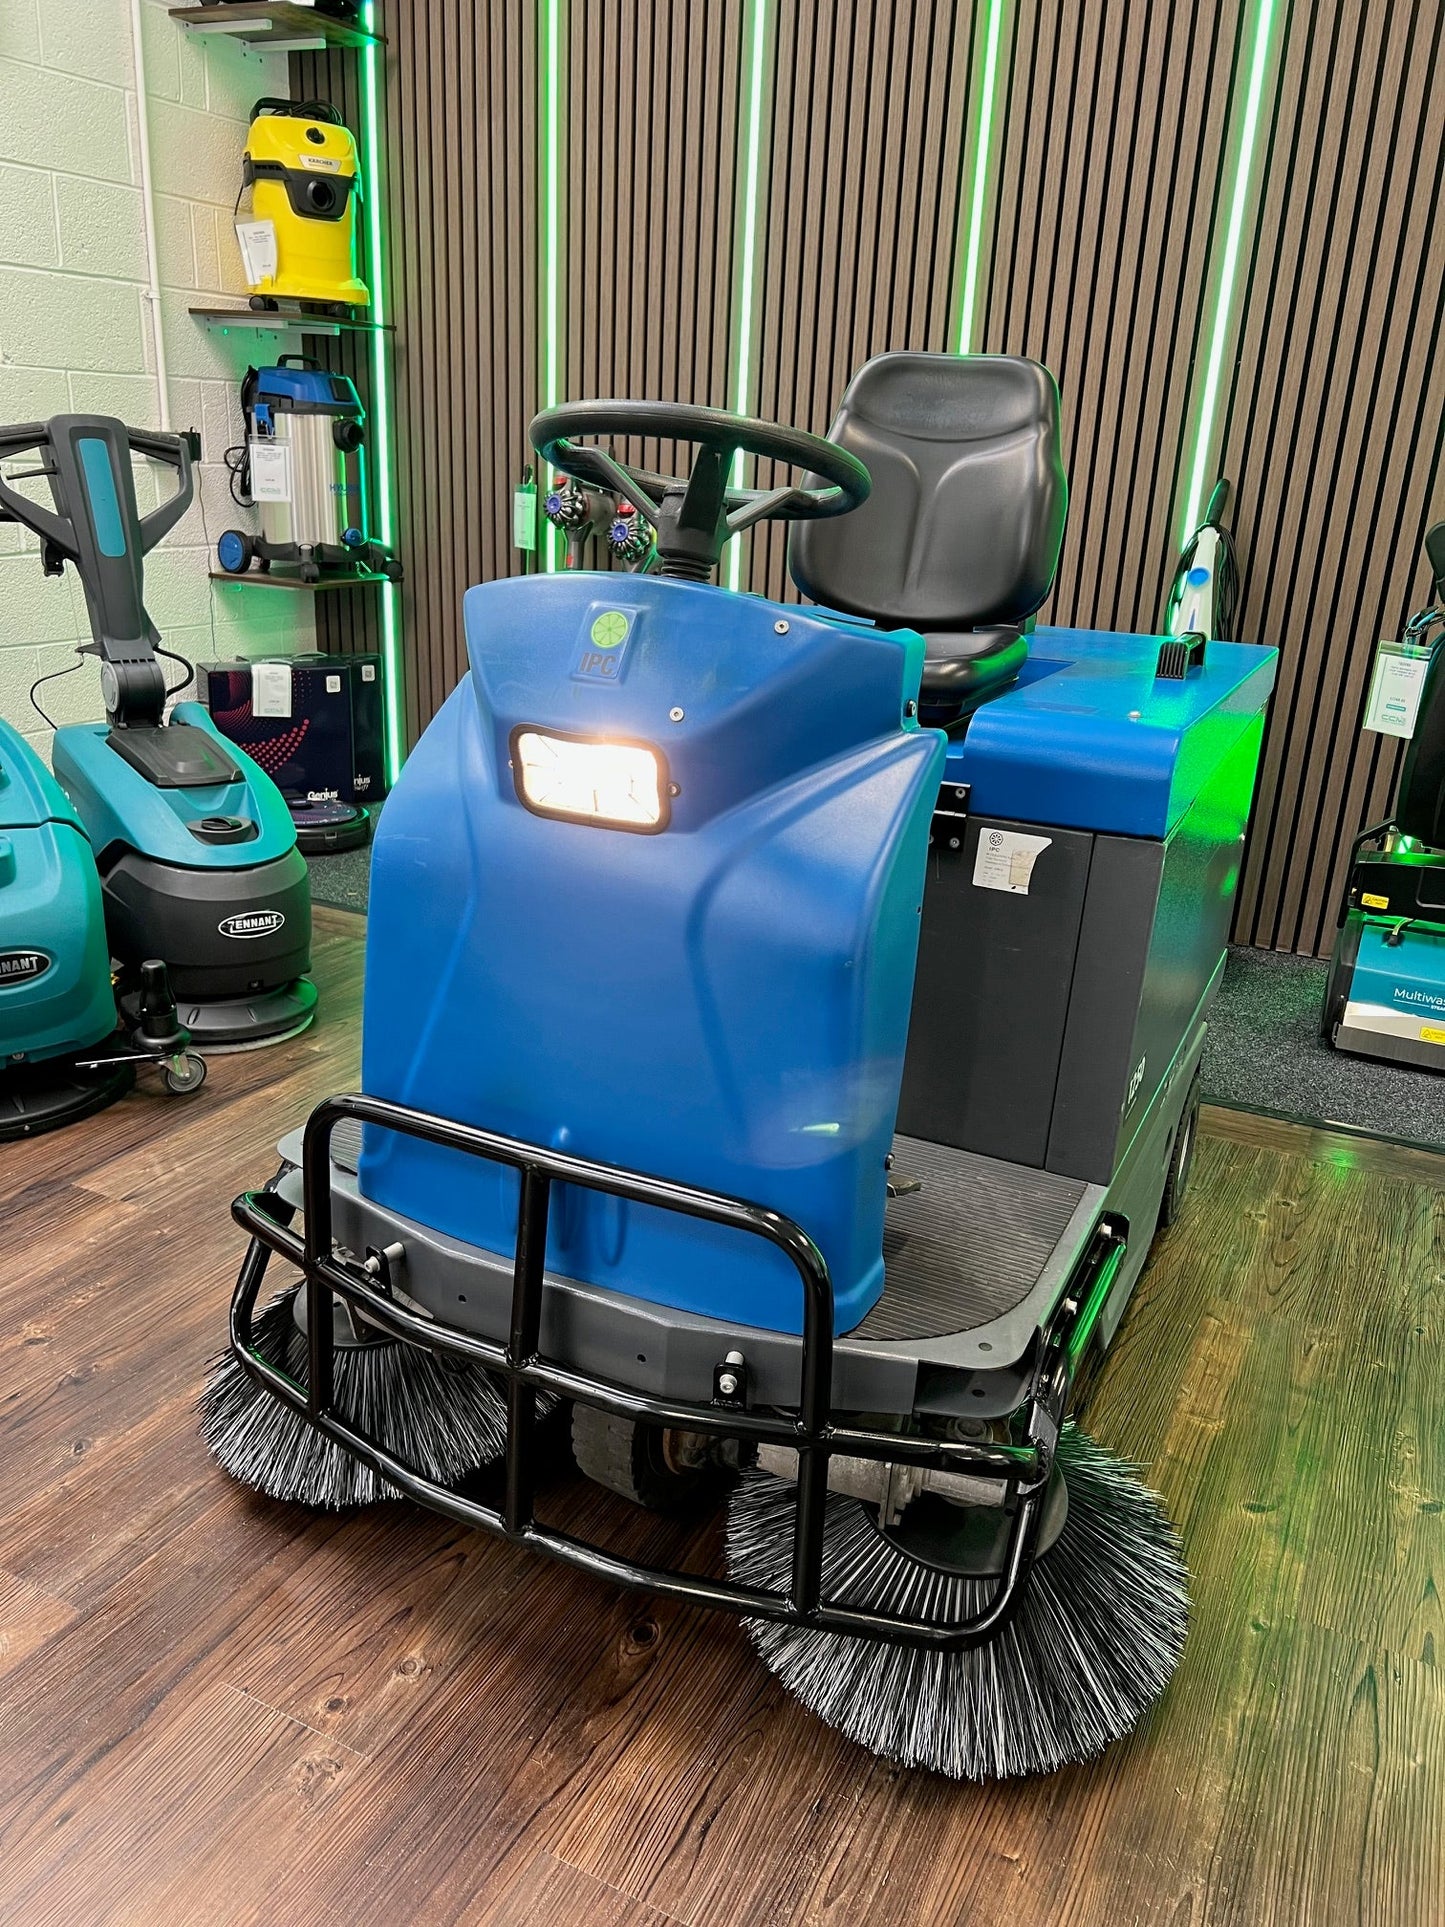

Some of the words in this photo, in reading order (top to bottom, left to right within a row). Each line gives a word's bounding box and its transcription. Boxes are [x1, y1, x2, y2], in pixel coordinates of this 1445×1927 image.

[580, 652, 616, 675] IPC
[354, 774, 370, 785] nius
[307, 788, 338, 801] Genius
[227, 914, 278, 934] TENNANT
[0, 956, 38, 974] NANT
